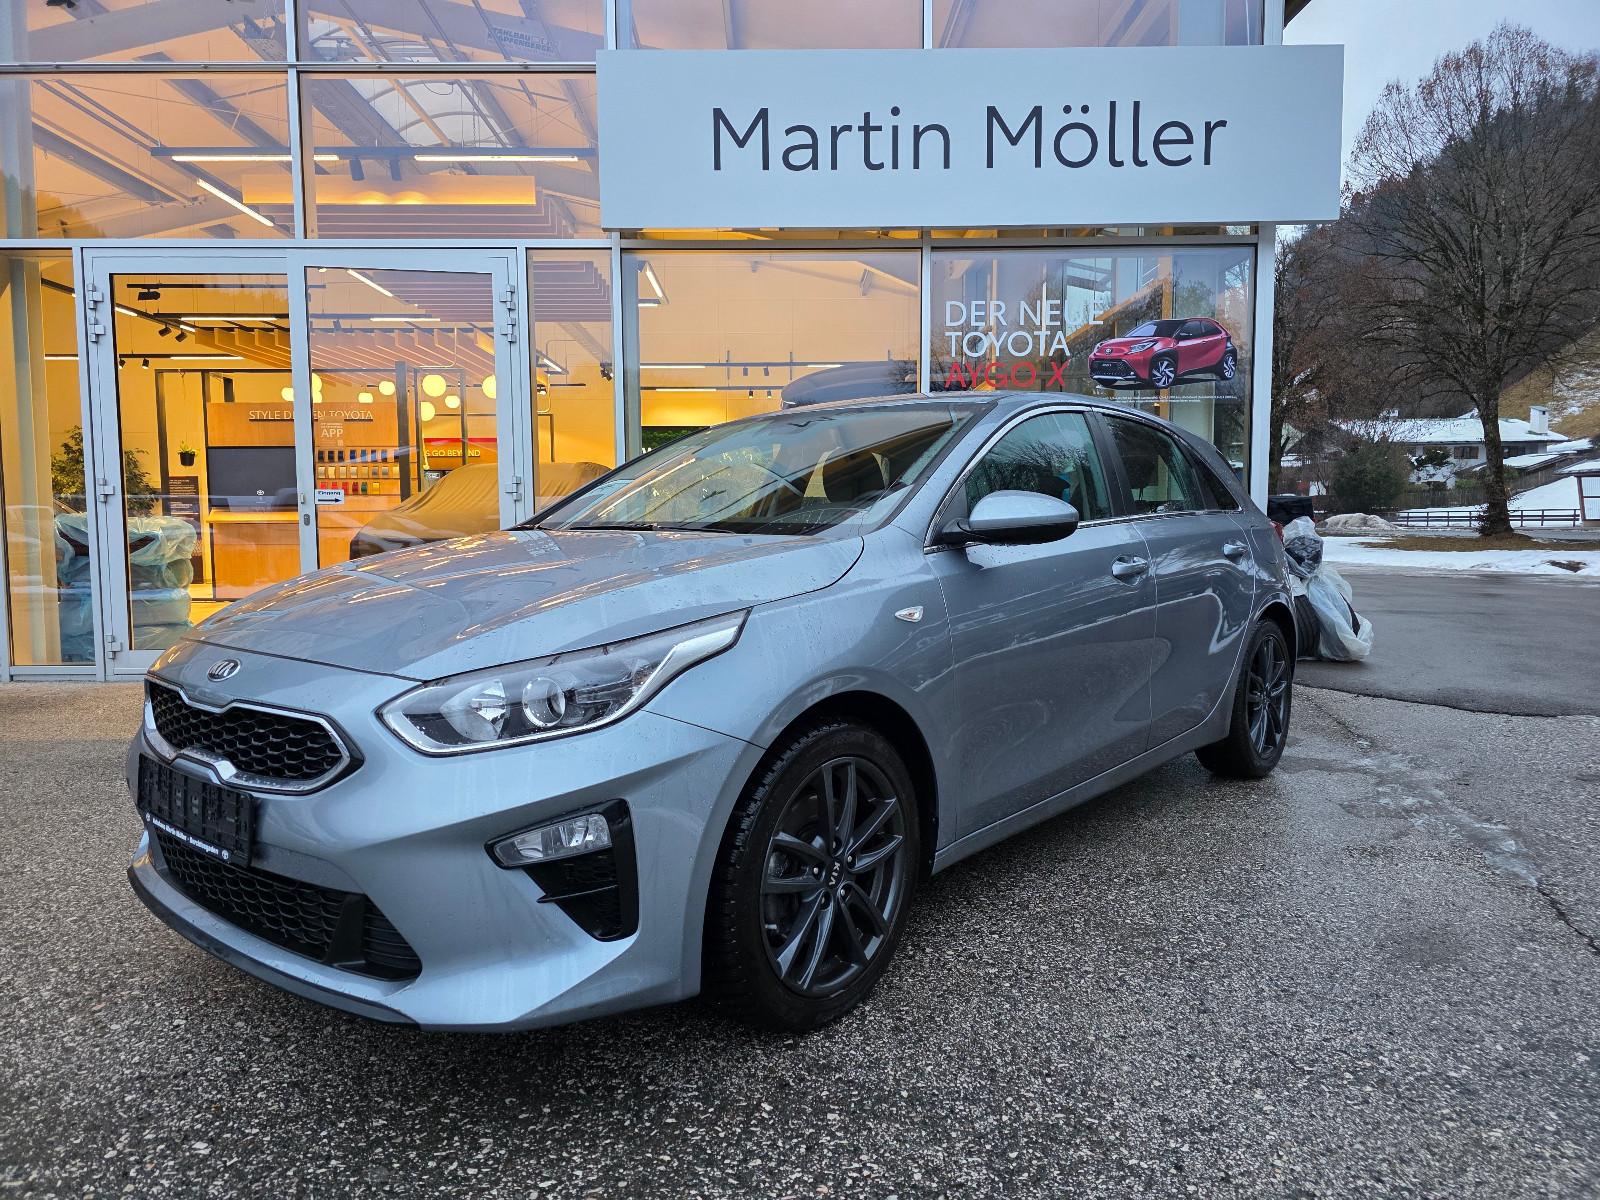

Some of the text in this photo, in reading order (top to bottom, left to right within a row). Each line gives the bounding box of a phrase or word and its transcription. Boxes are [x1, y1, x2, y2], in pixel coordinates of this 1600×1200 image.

[712, 100, 1228, 171] Martin Möller
[945, 299, 1104, 326] DER NEUE
[944, 330, 1071, 358] TOYOTA
[944, 359, 1070, 389] AYGO X
[248, 410, 281, 420] STYLE
[328, 410, 373, 420] TOYOTA
[321, 428, 343, 438] APP
[431, 449, 446, 457] GO
[447, 449, 480, 457] BEYND
[828, 861, 841, 886] KIA
